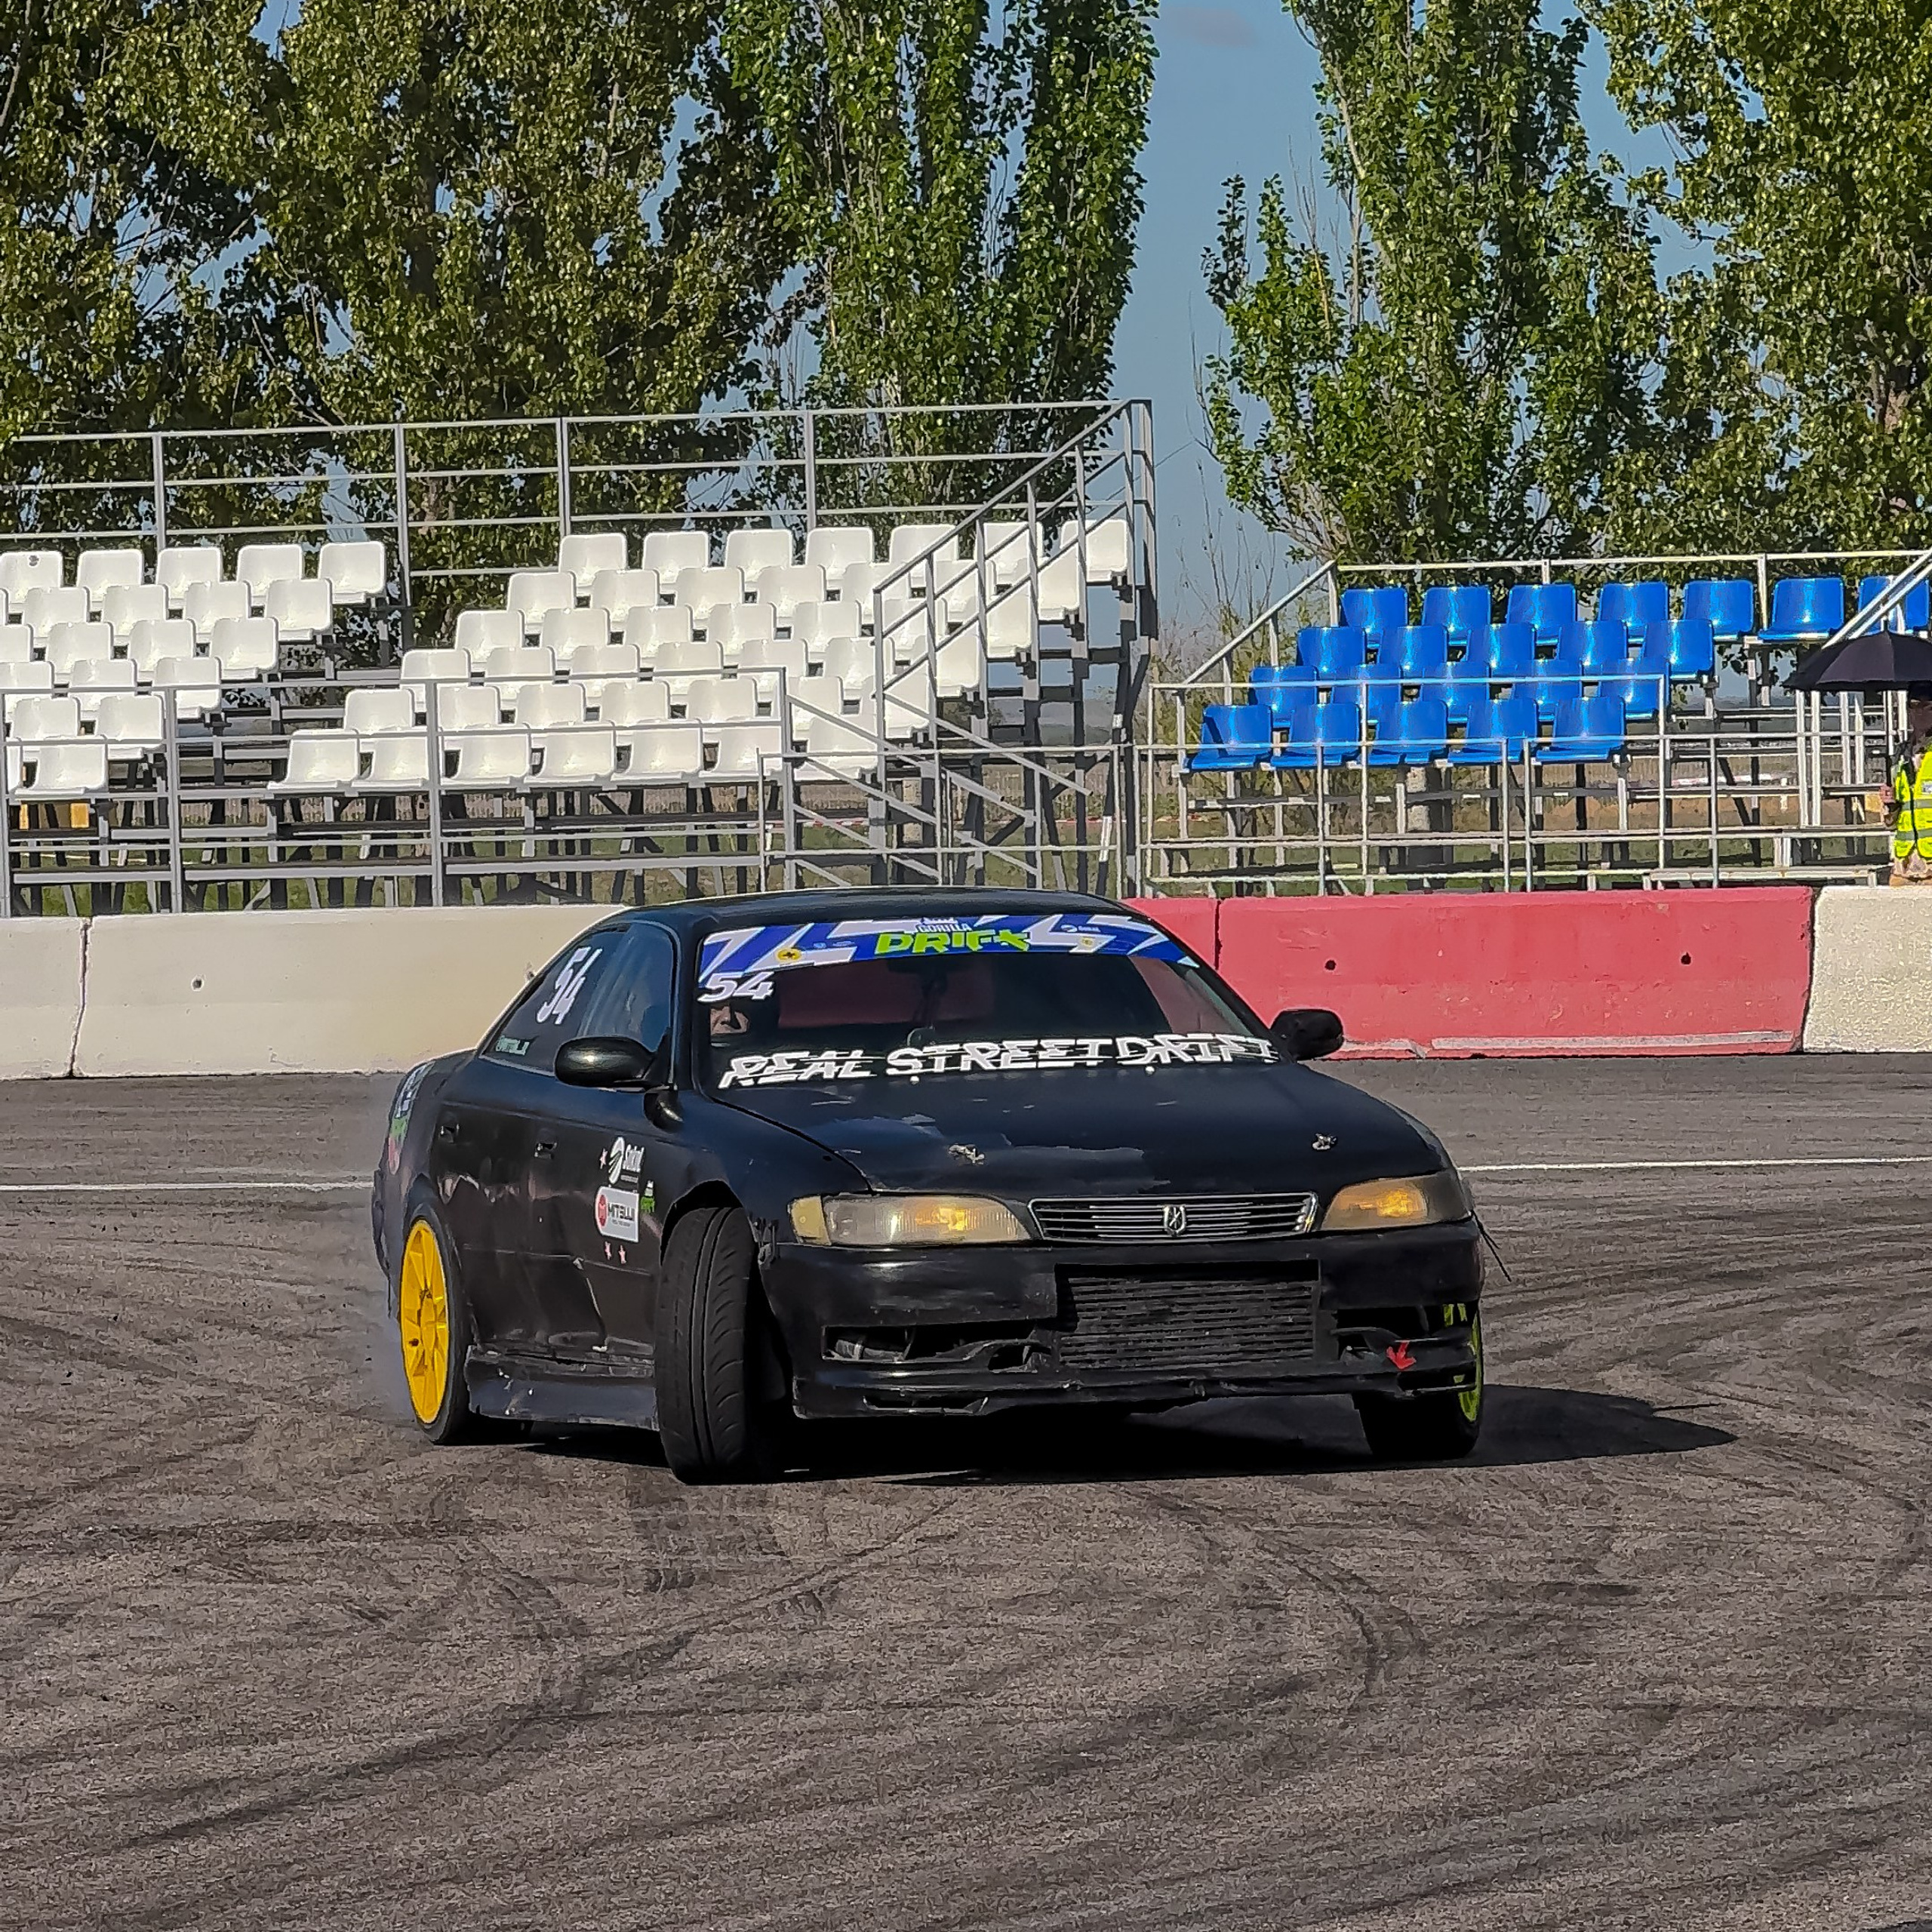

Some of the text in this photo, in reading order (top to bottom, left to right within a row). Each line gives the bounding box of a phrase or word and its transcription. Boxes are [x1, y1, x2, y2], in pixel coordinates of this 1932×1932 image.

[537, 946, 603, 1025] 54
[697, 971, 775, 1002] 54
[718, 1049, 885, 1089] REAL
